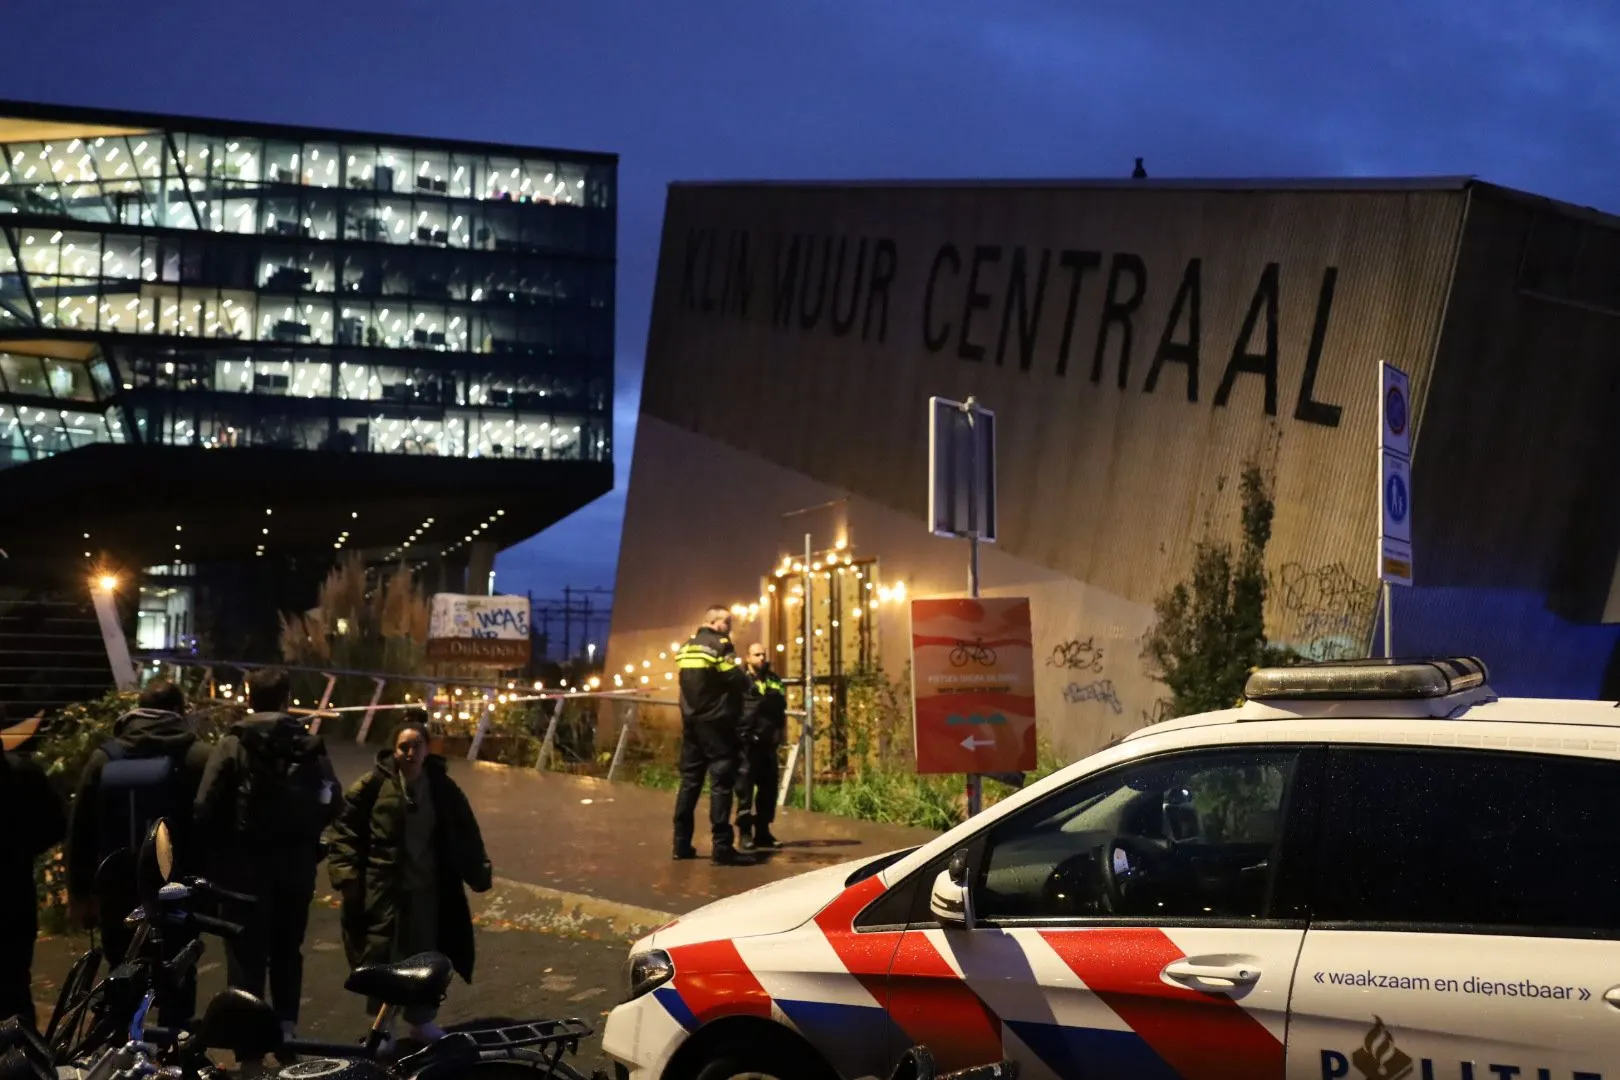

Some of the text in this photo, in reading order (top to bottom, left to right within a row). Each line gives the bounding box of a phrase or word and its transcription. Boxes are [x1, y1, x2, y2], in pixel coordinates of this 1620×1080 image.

[923, 244, 1342, 427] CENTRAAL
[1328, 970, 1430, 990] waakzaam
[1434, 978, 1458, 992] en
[1463, 976, 1573, 999] dienstbaar
